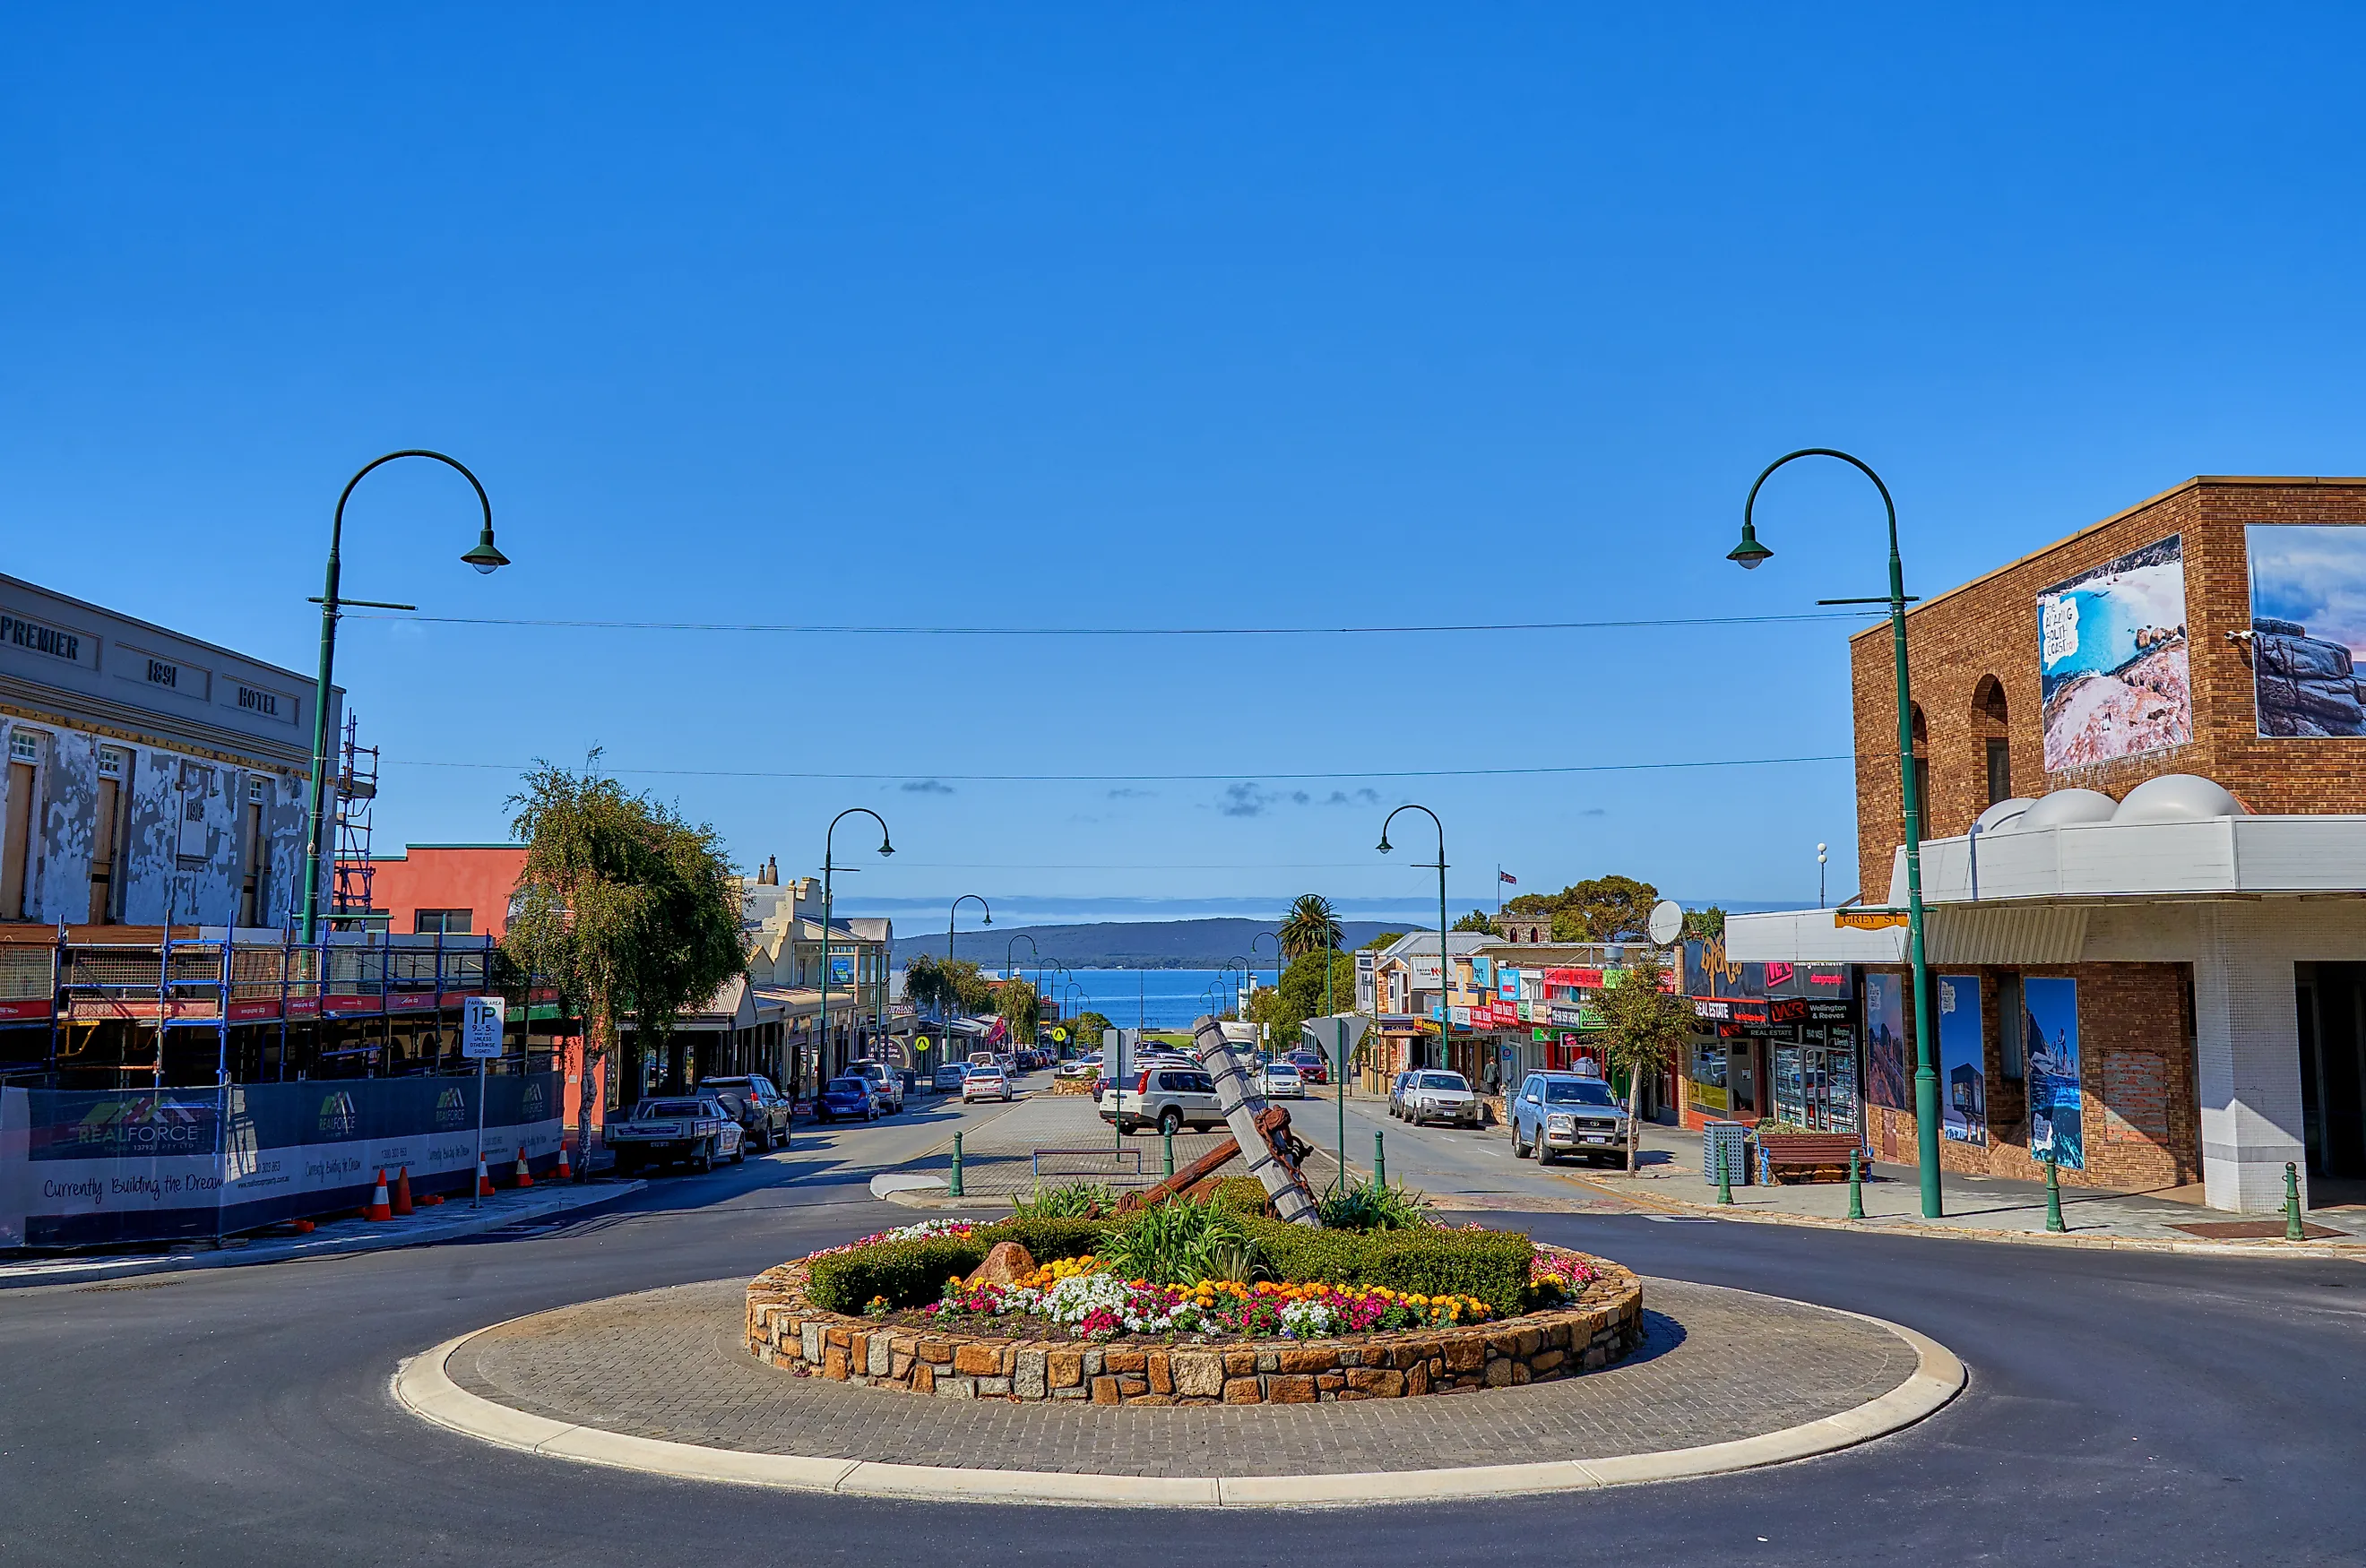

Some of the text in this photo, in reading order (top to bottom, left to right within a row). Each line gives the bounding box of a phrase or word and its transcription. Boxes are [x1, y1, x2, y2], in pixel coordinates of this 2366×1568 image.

[0, 616, 79, 660] PREMIER
[147, 659, 177, 687] 1891
[238, 686, 279, 716] HOTEL
[1843, 915, 1899, 924] GREY ST
[472, 1006, 497, 1024] 1P
[1709, 1002, 1730, 1020] ESTATE
[1809, 1004, 1847, 1013] Wellington
[79, 1125, 198, 1143] REALFORCE
[45, 1173, 224, 1204] Currently Building the Dream
